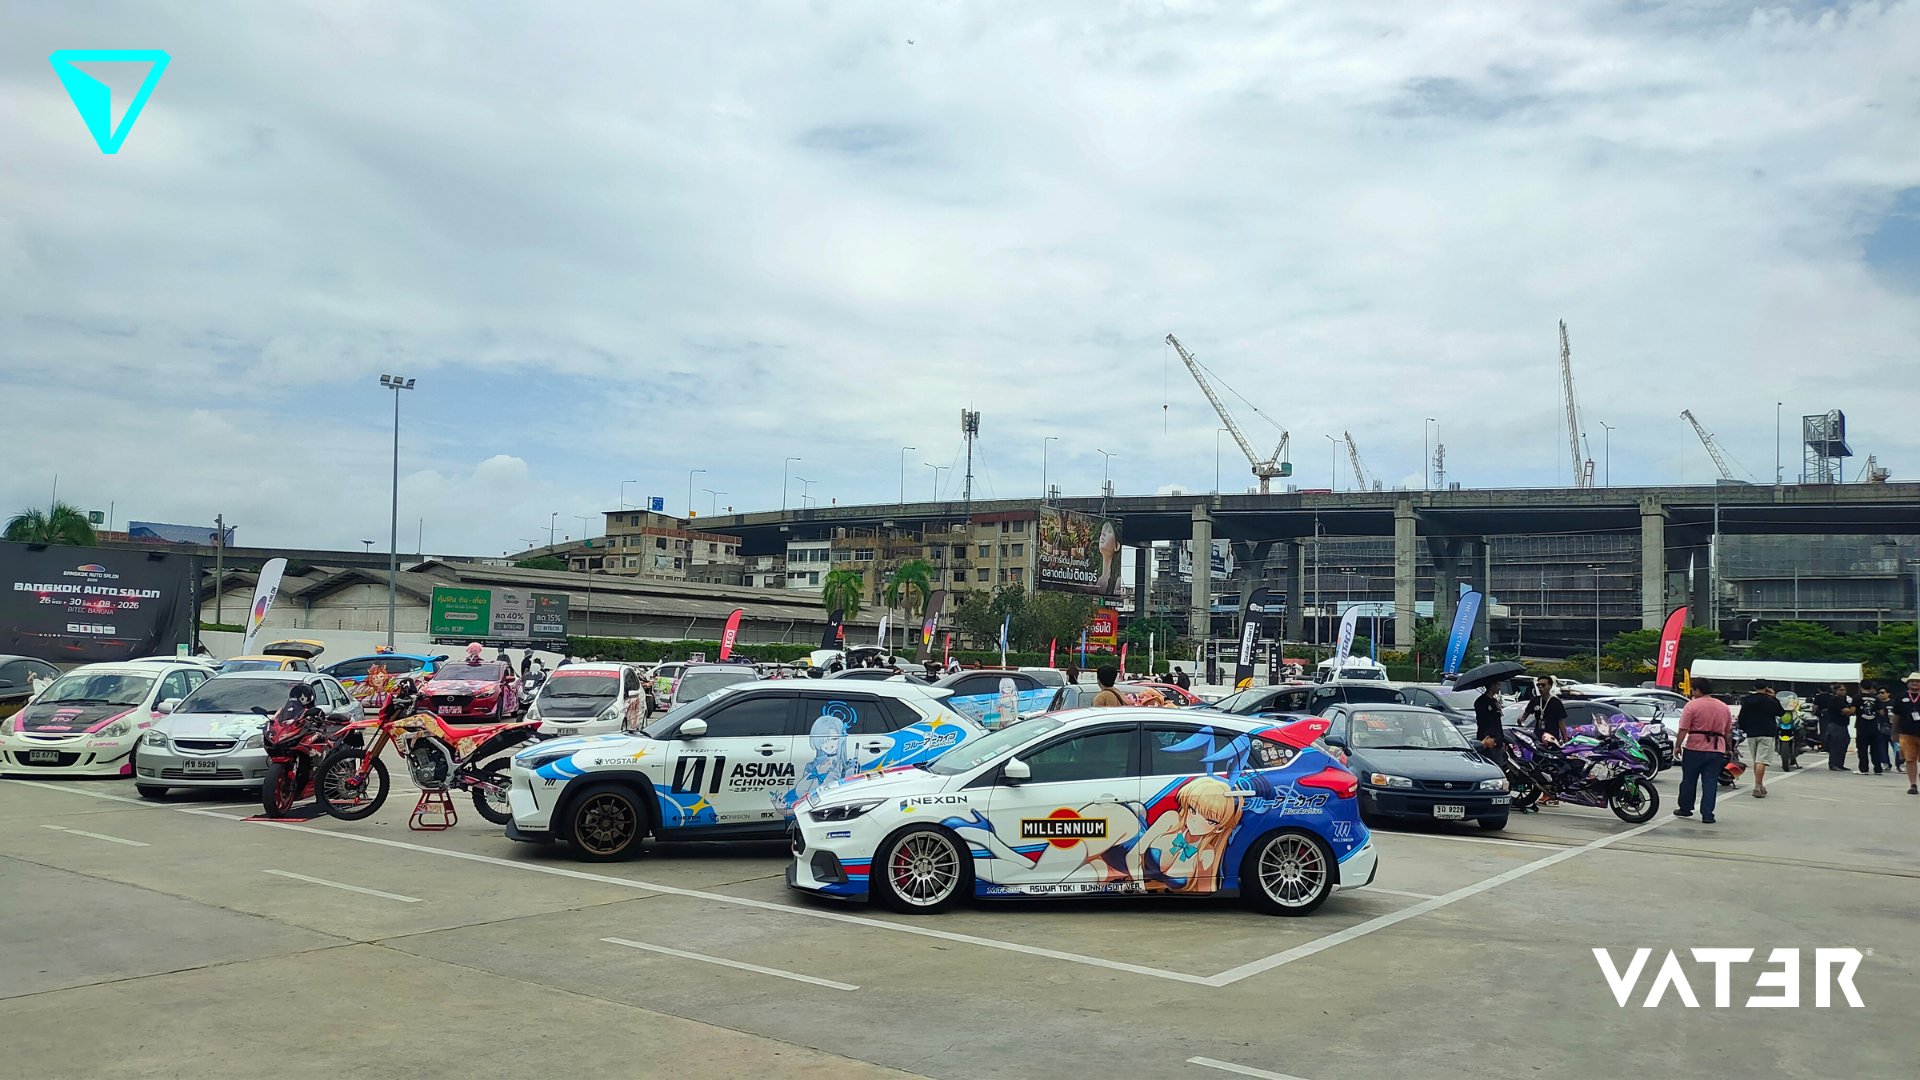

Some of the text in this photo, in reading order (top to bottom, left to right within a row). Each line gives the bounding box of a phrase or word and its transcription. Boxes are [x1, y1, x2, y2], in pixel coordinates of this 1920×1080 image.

[14, 582, 161, 598] BANGKOK AUTO SALON
[38, 596, 51, 604] 26
[69, 598, 82, 606] 30
[98, 600, 110, 608] 08
[118, 602, 140, 610] 2026
[1464, 601, 1472, 612] THE
[507, 612, 524, 620] 40%
[547, 614, 562, 622] 15%
[726, 631, 734, 646] LEO
[1243, 624, 1254, 663] Solar Gard
[198, 760, 216, 768] 5929
[730, 762, 796, 778] ASUNA
[670, 756, 726, 794] 01
[729, 778, 796, 786] ICHINOSE
[911, 796, 968, 806] NEXON
[1241, 793, 1330, 811] ブルーアーカイブ
[1024, 822, 1104, 835] MILLENNIUM
[1058, 884, 1076, 892] TOKI
[1080, 884, 1105, 892] BUNNY
